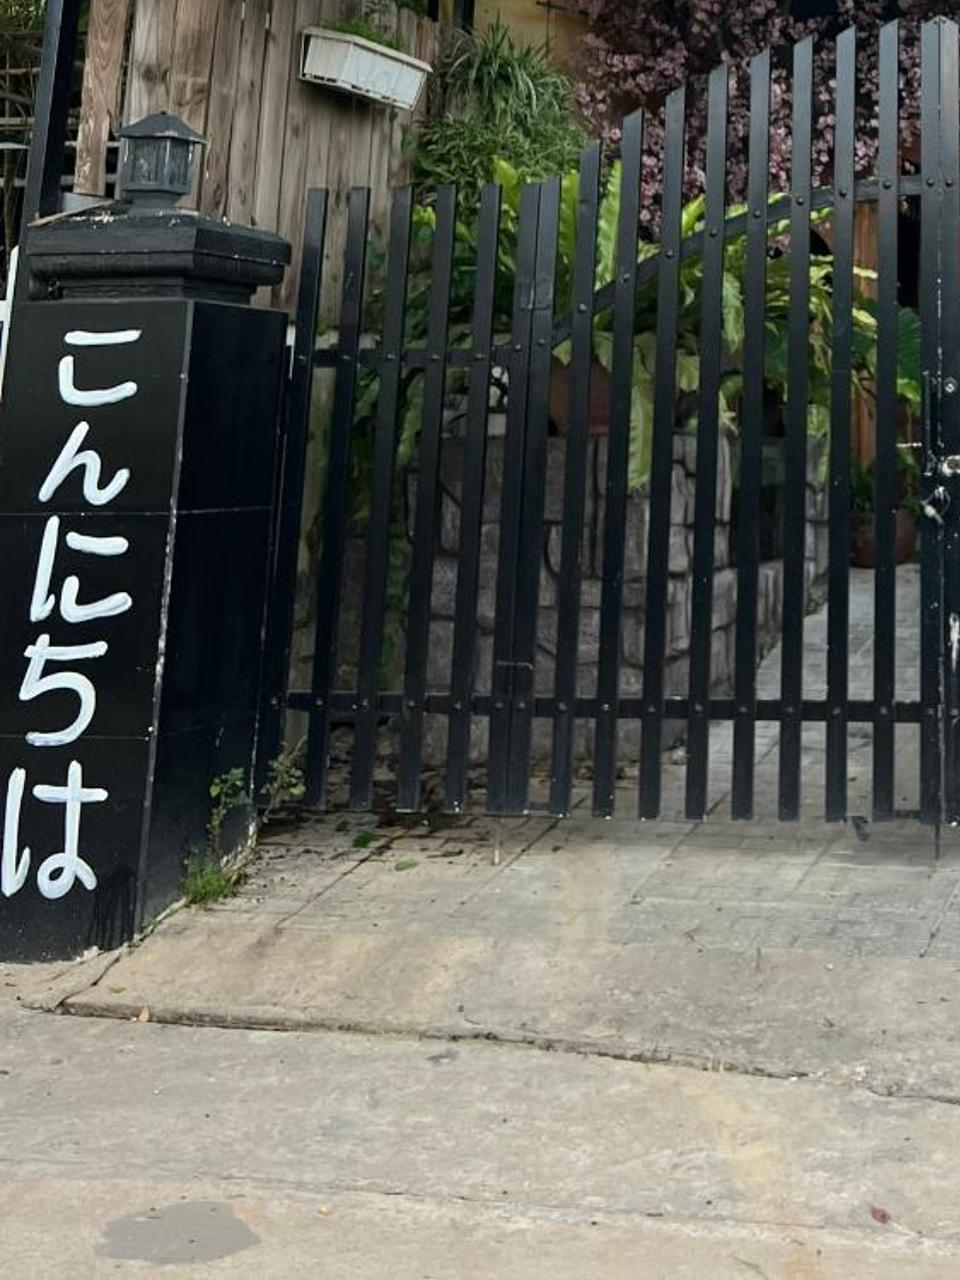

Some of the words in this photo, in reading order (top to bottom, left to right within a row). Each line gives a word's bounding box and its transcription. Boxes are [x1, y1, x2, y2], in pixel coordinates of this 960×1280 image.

[1, 329, 142, 899] こんにちは
